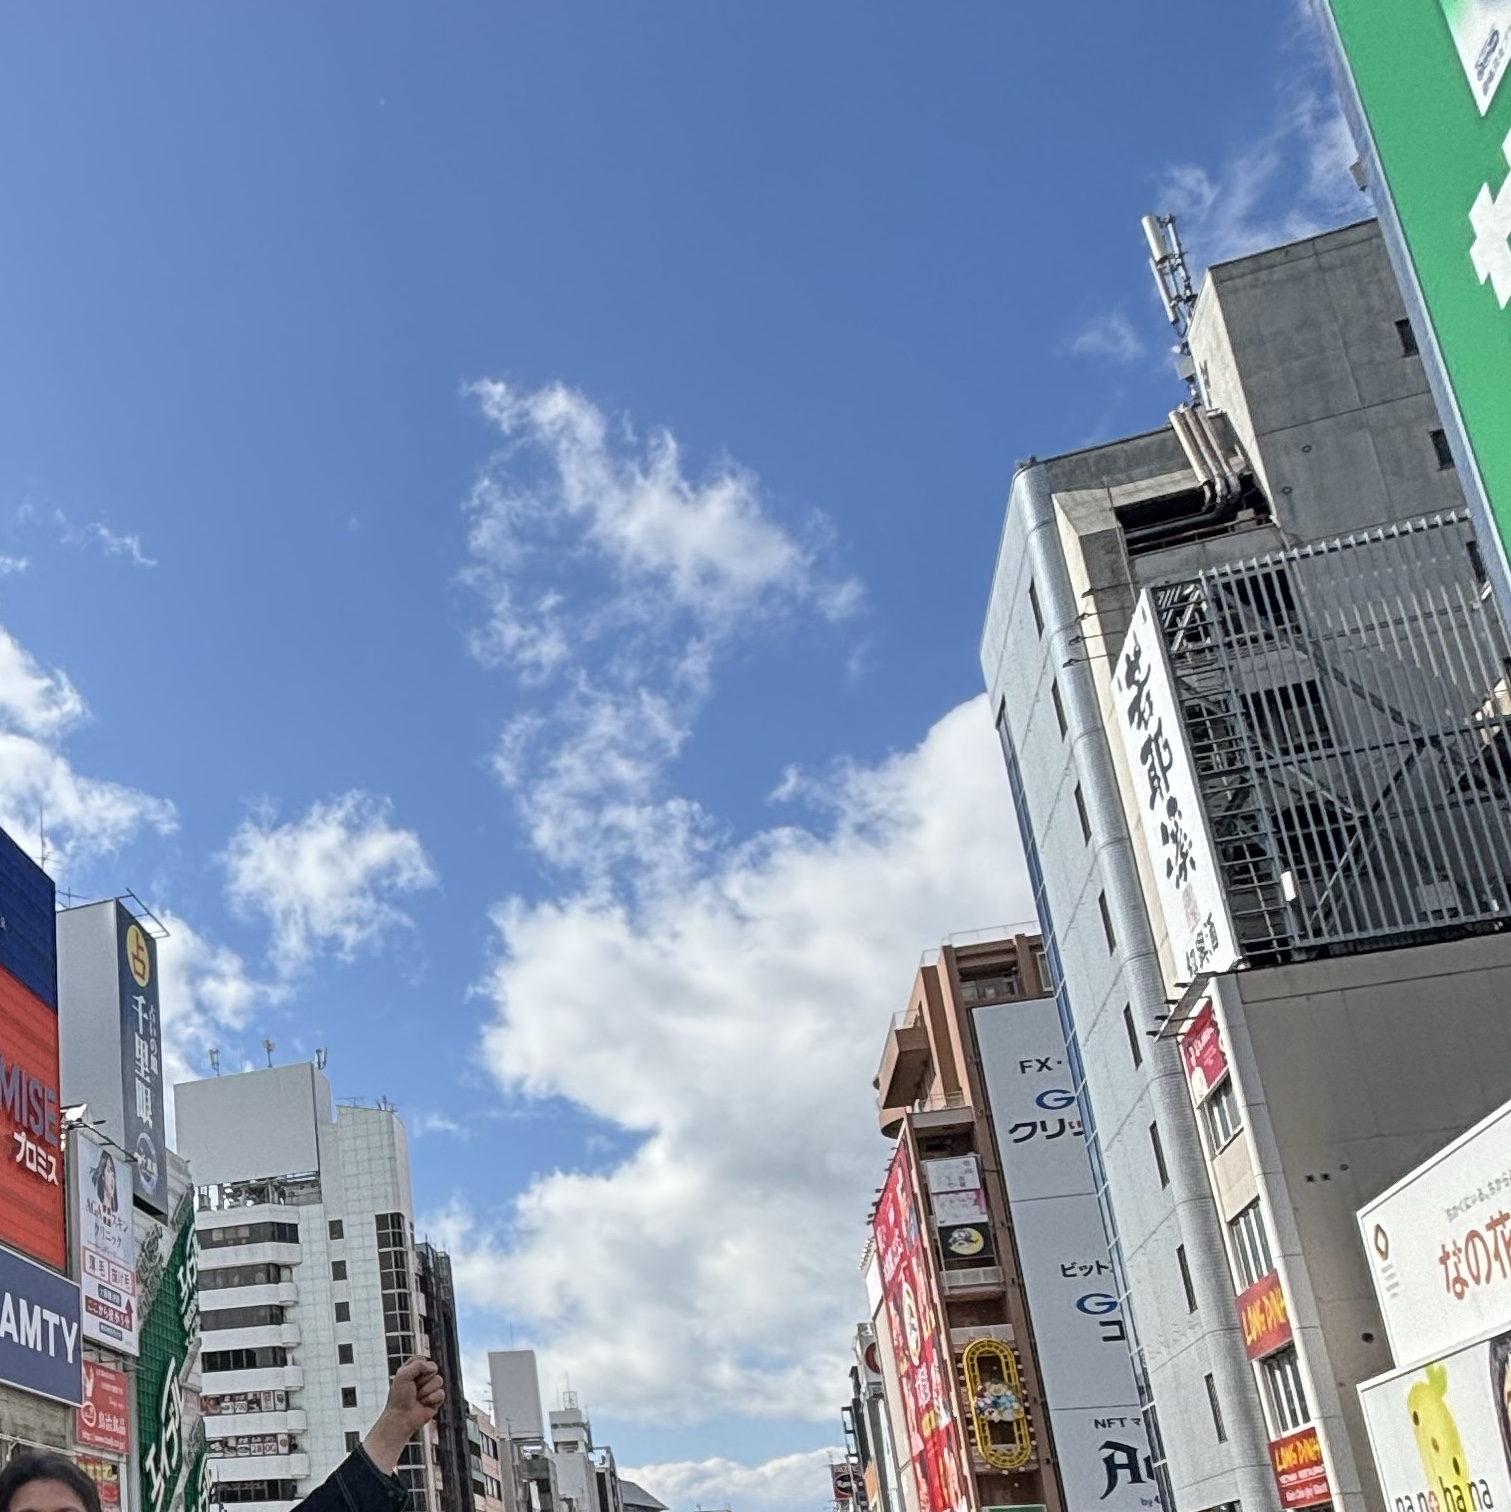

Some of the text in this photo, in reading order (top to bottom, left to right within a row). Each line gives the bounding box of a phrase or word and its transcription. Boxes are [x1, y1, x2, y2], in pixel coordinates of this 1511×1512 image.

[131, 994, 153, 1130] 千里眼
[13, 1131, 59, 1187] プロミス
